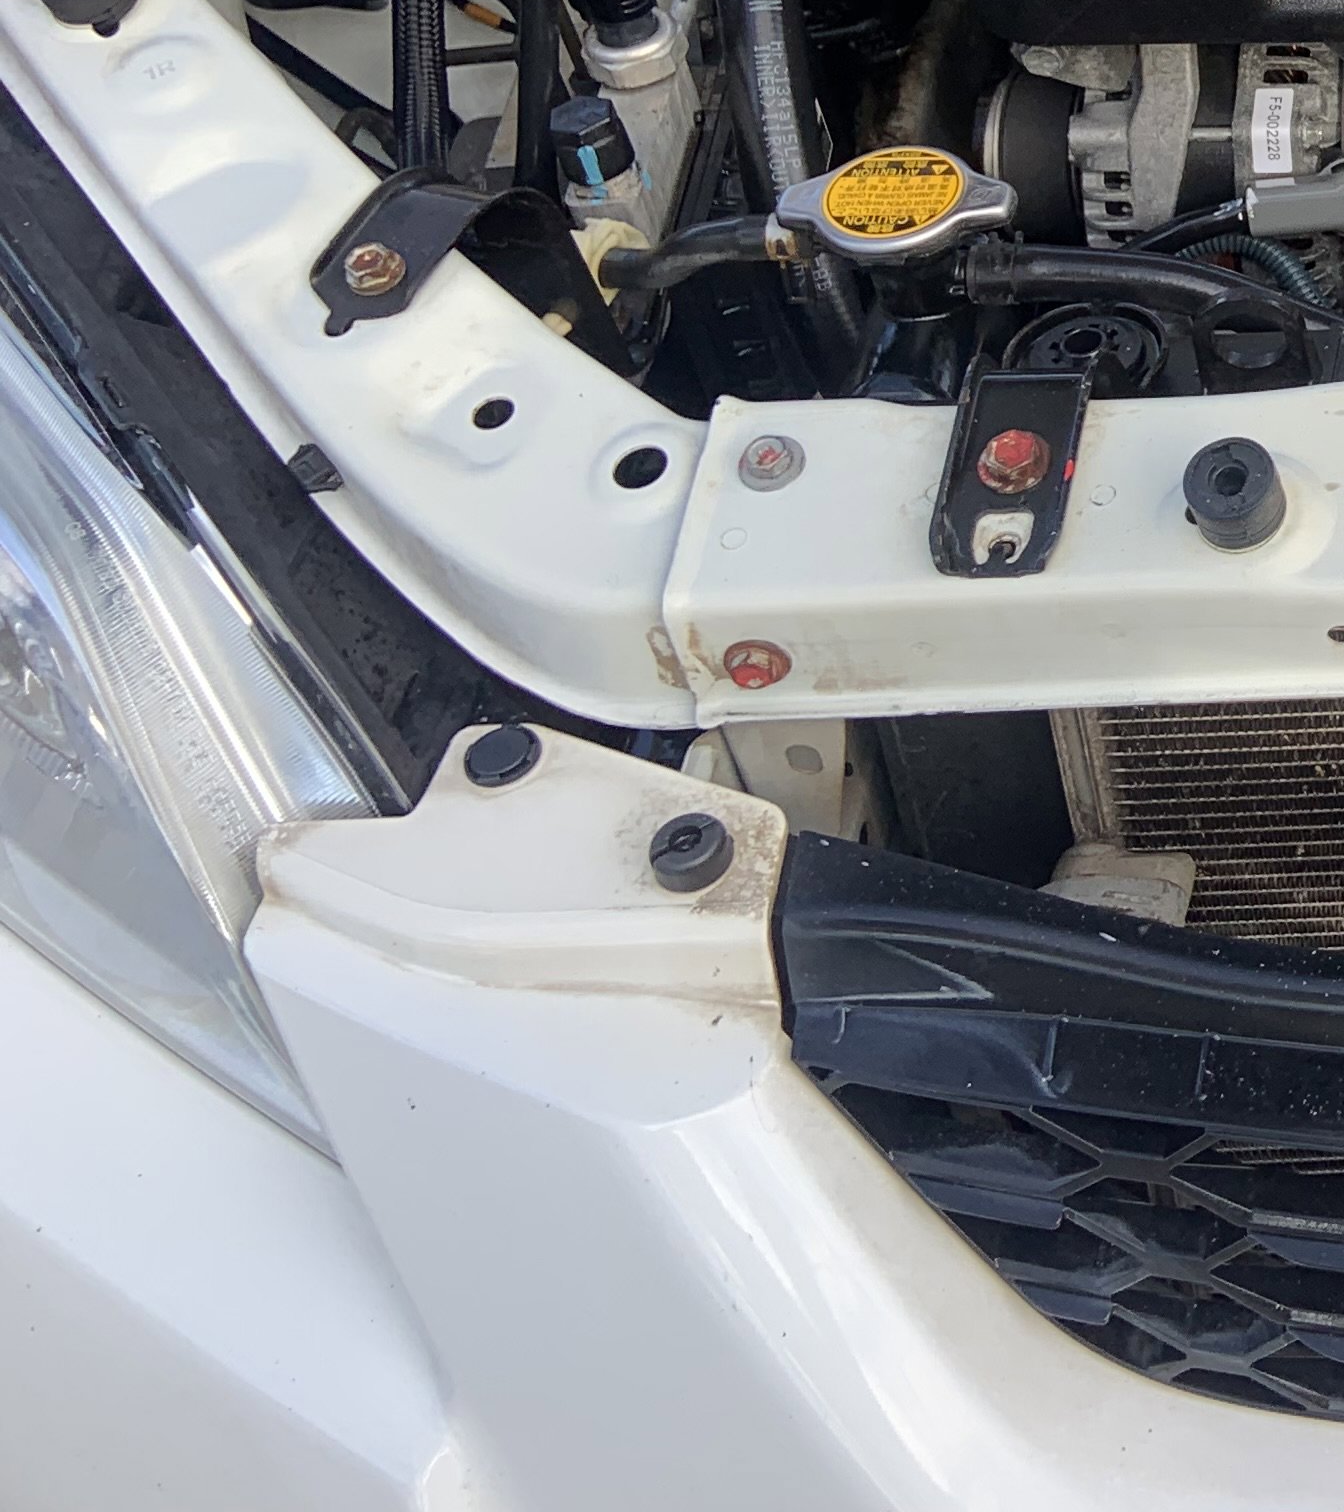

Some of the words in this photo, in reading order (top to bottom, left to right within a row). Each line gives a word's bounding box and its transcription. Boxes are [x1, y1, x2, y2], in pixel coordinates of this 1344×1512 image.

[1265, 96, 1283, 161] F5-002228
[851, 168, 919, 176] ATTENTION
[842, 215, 909, 225] CAUTION
